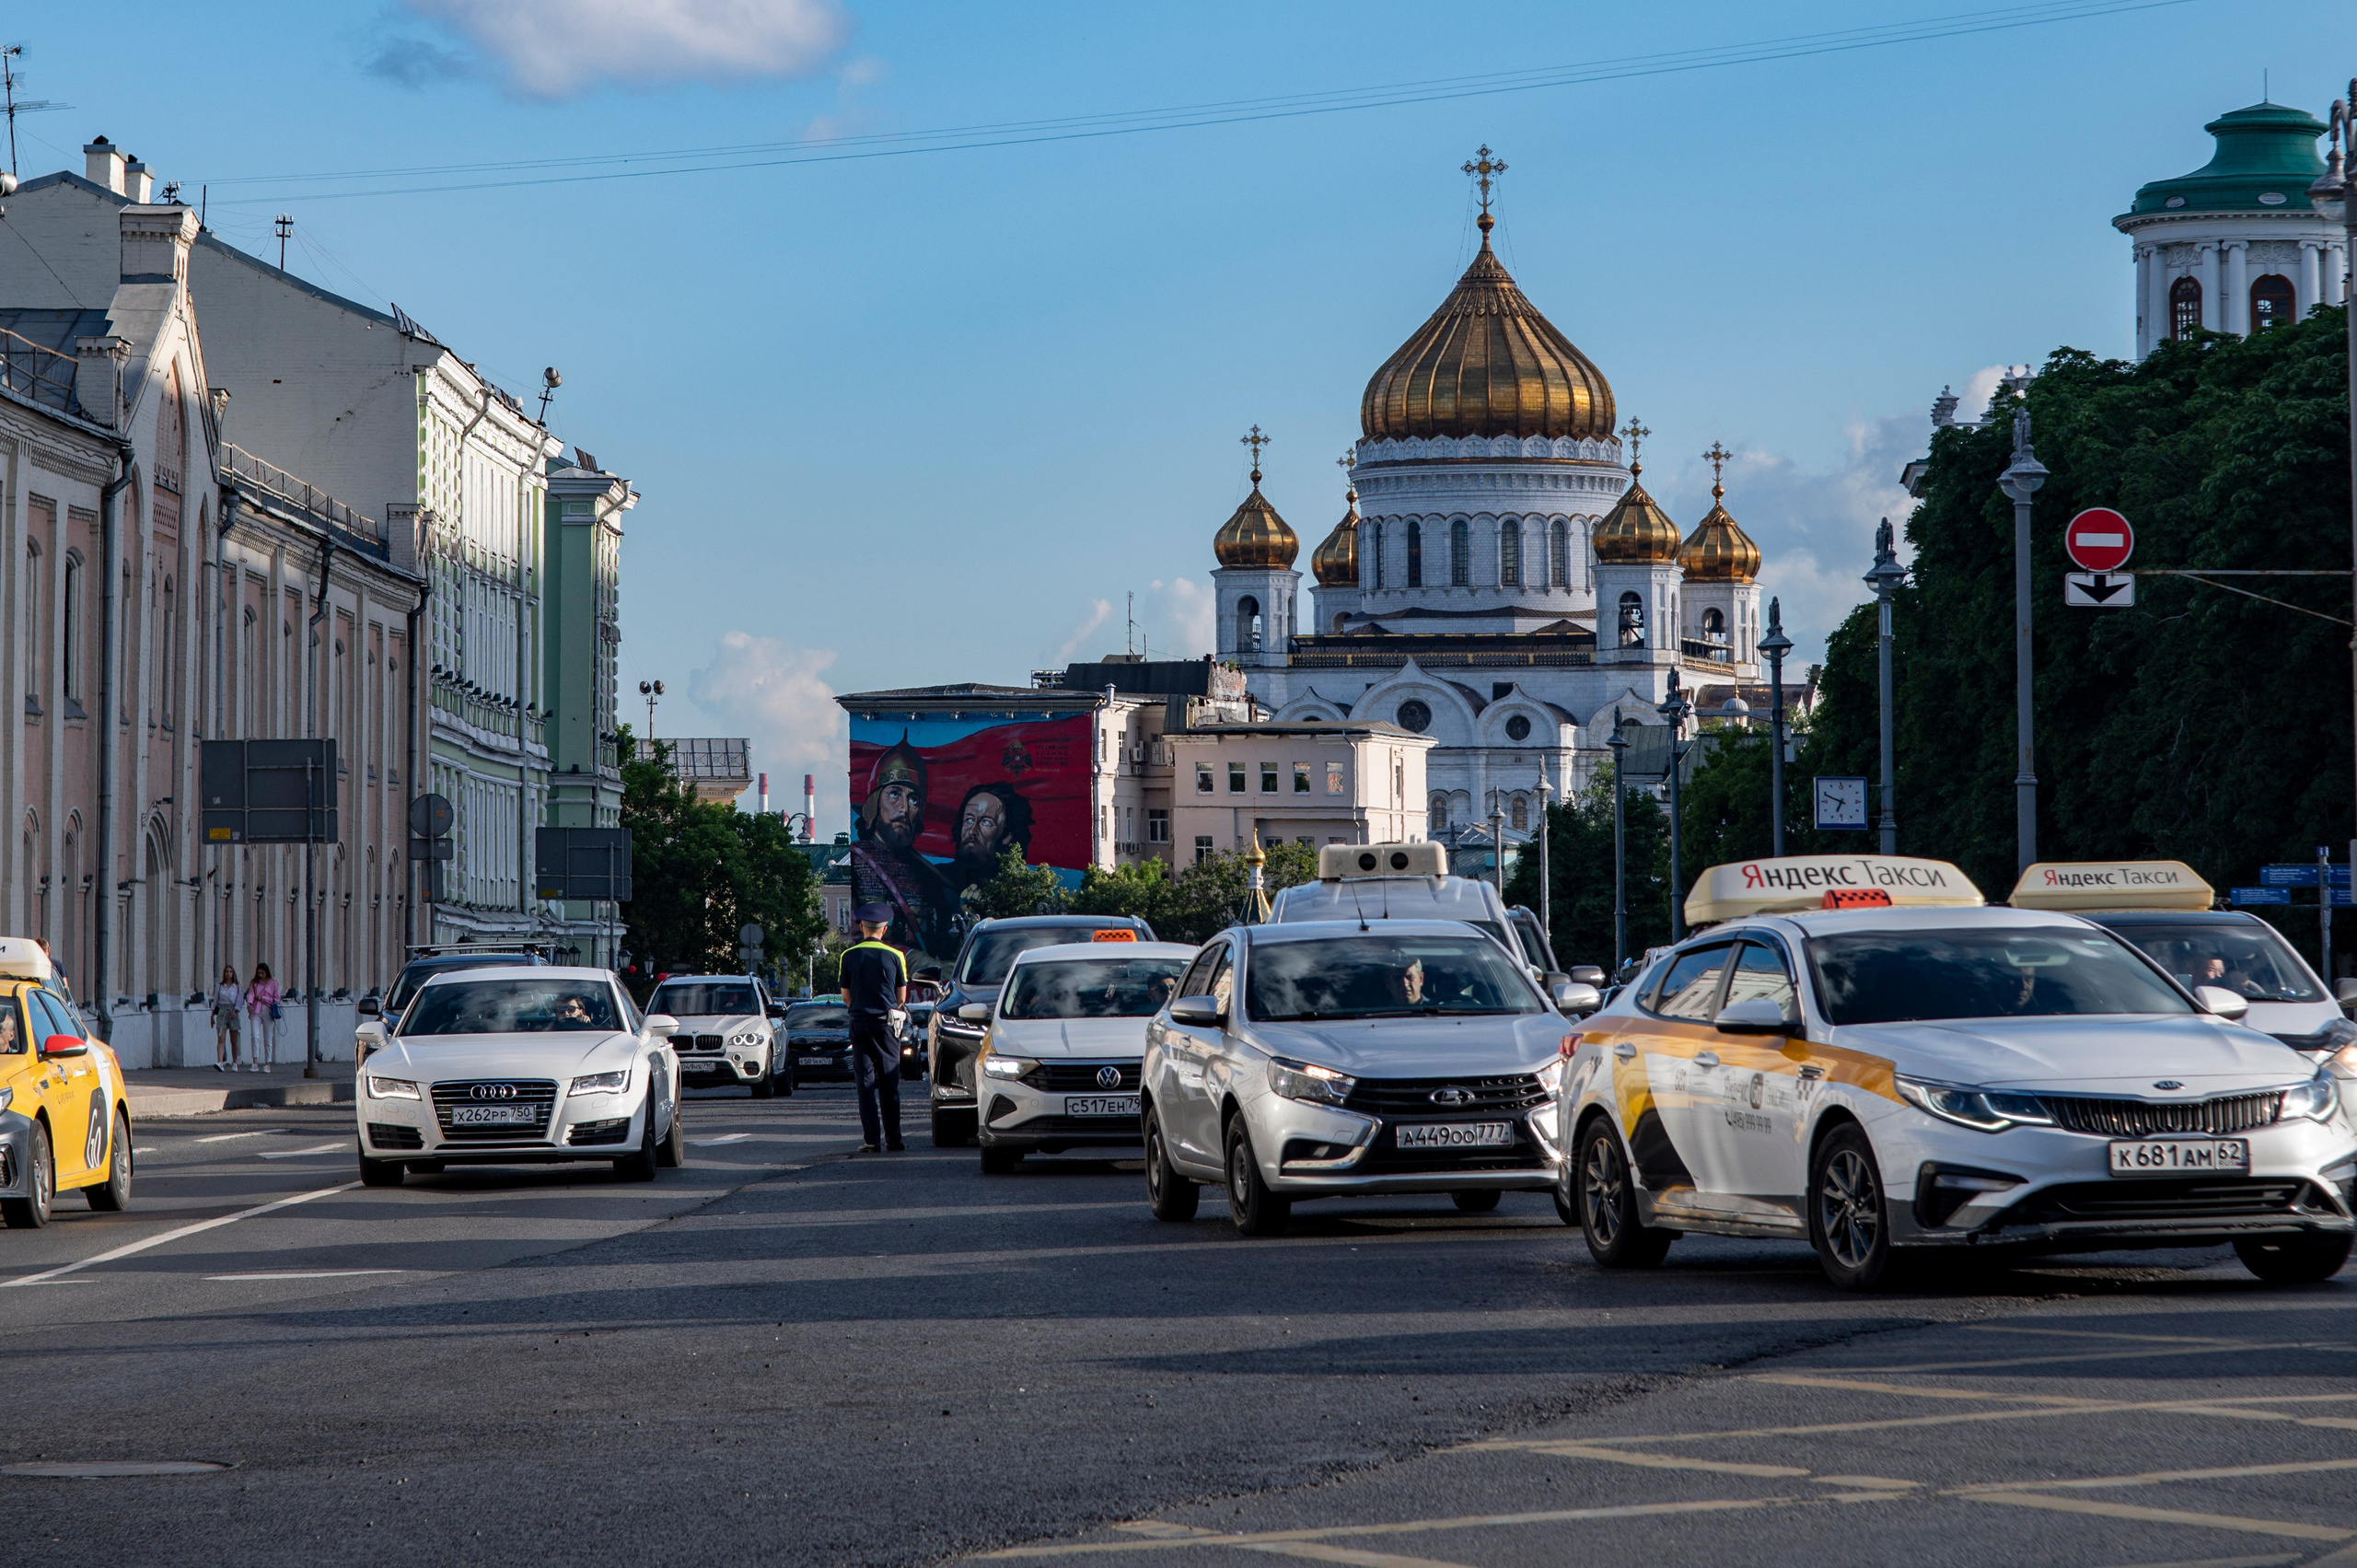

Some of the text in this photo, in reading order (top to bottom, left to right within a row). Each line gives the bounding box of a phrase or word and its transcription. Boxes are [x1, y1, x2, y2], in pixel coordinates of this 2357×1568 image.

[1741, 860, 1946, 889] Яндекс Такси
[2043, 868, 2179, 887] Яндекс Такси
[457, 1108, 530, 1121] Х262РР 750
[1071, 1098, 1141, 1112] С517ЕН 79
[1403, 1124, 1504, 1145] А449ОО 777
[2119, 1142, 2241, 1167] К681АМ 62
